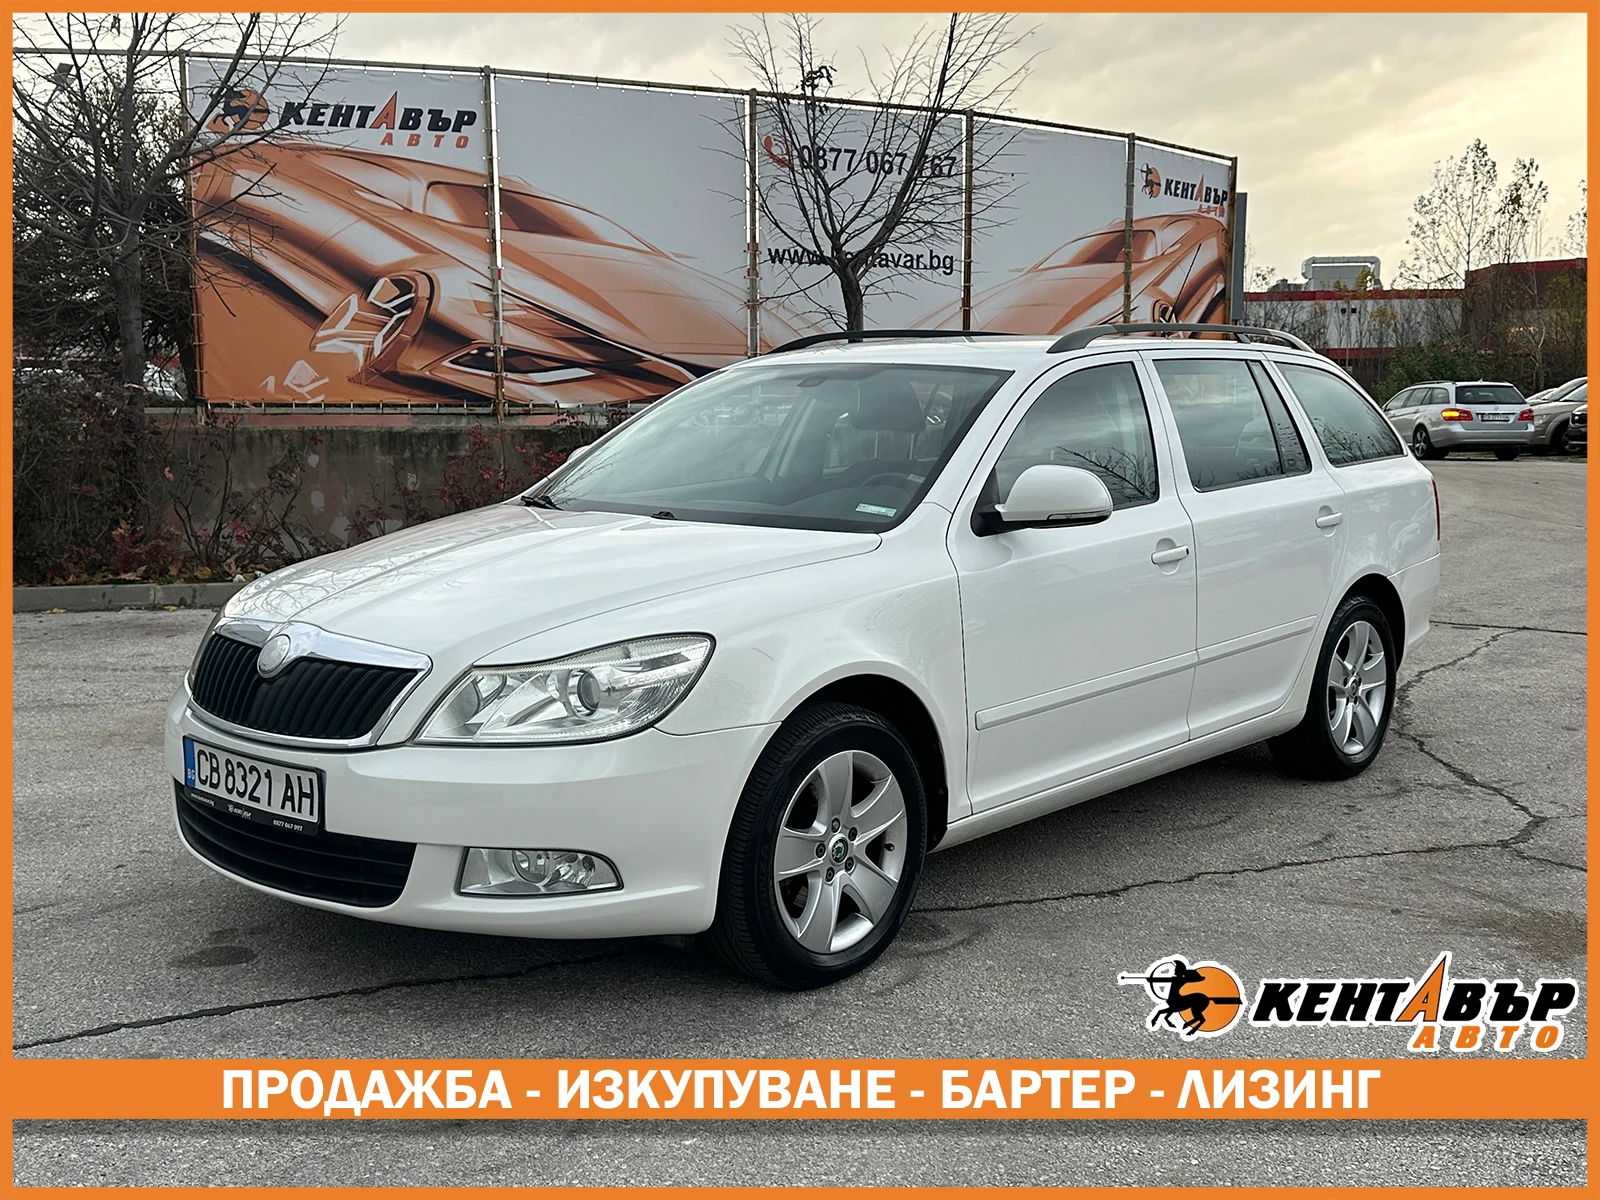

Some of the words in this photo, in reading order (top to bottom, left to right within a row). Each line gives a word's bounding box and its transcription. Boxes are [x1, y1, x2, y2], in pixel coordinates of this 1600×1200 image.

[281, 90, 477, 133] КЕНТАВЪР
[380, 133, 470, 148] АВТО
[800, 145, 857, 172] 0877
[866, 150, 907, 176] 067
[1164, 173, 1229, 206] КЕНТАВЪР
[767, 247, 955, 275] www.avar.bg
[187, 768, 196, 780] BG
[225, 758, 273, 807] 8321
[281, 773, 314, 816] AH
